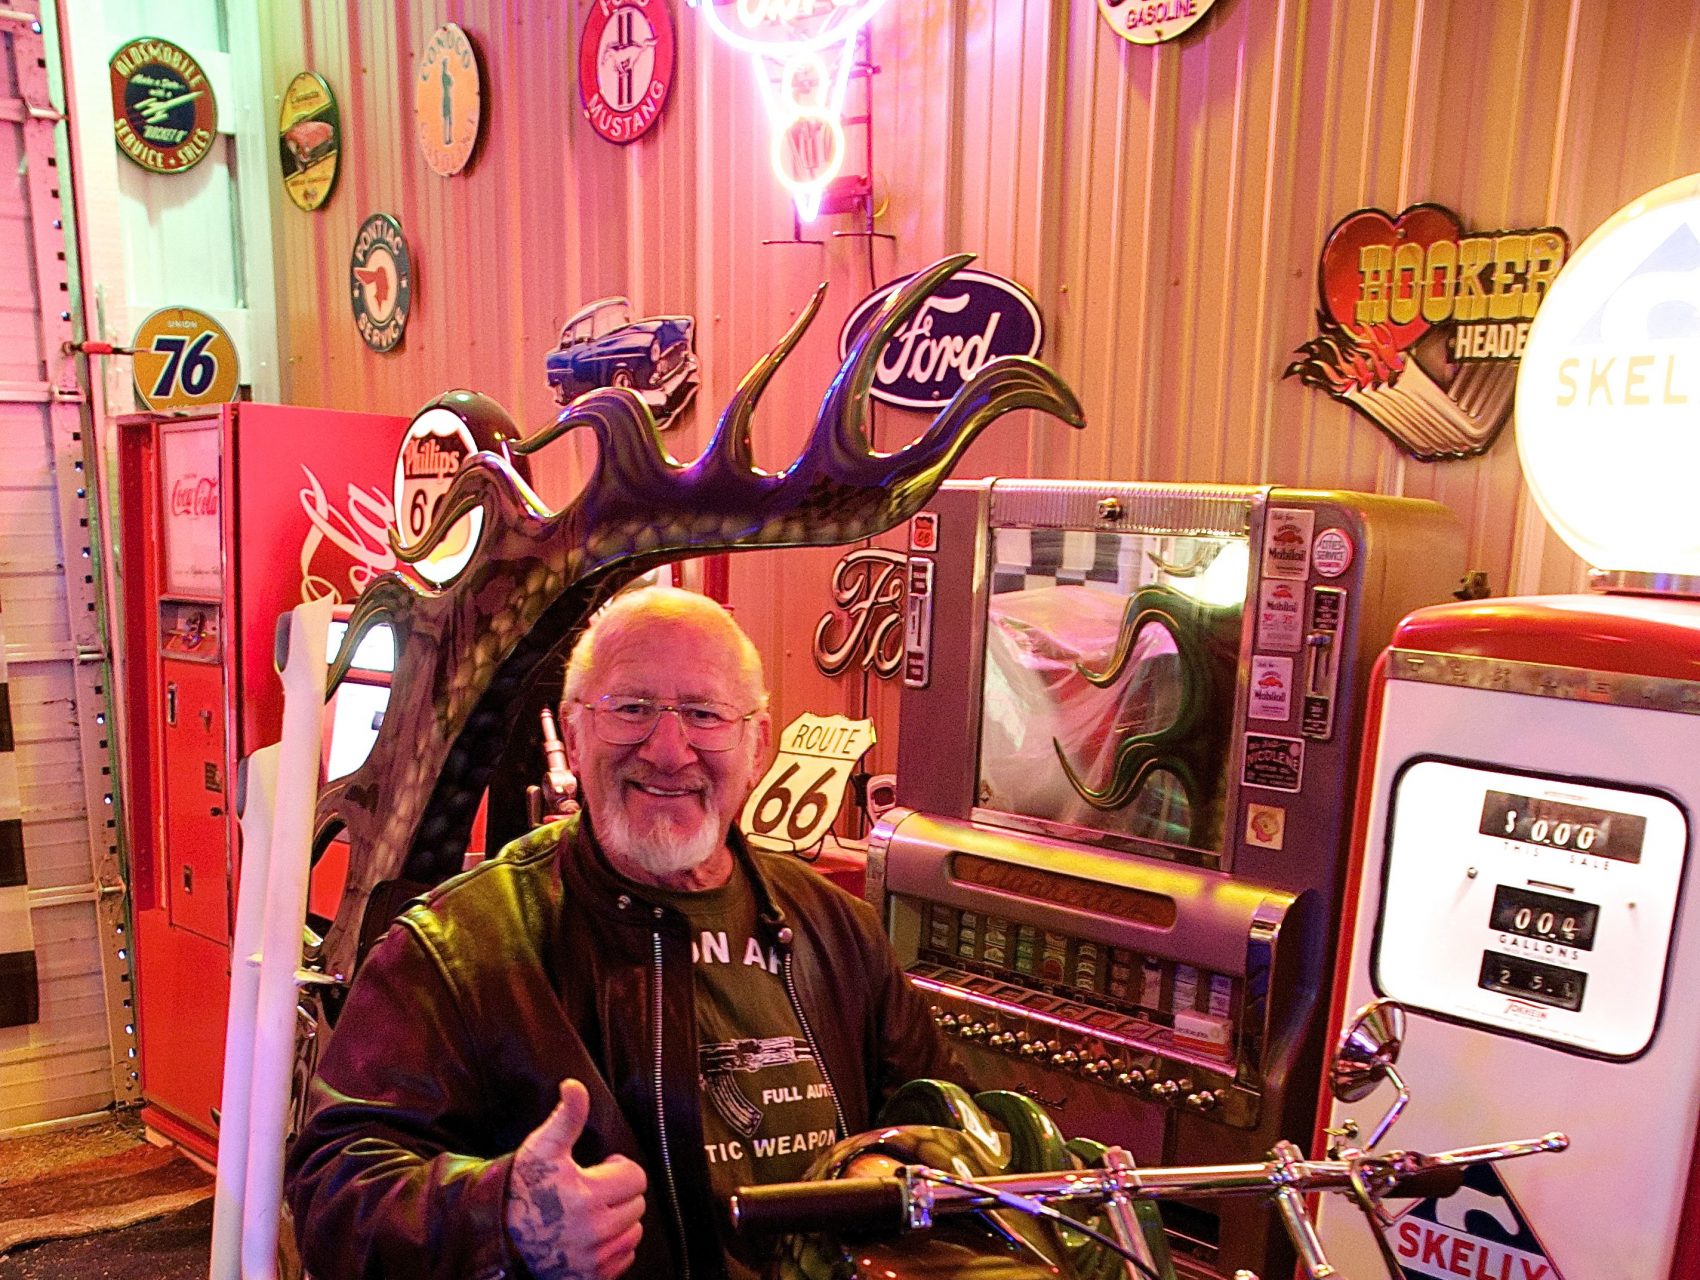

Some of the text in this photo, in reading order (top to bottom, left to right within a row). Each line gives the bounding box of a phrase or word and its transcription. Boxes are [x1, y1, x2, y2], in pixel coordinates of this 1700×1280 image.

[1127, 0, 1197, 29] GASOLINE
[115, 42, 203, 88] OLDSMOBILE
[589, 80, 664, 139] MUSTANG
[114, 118, 210, 168] SERVICE SALES
[355, 219, 402, 262] PONTIAC
[1356, 233, 1565, 325] HOOKER
[876, 293, 1001, 385] Ford
[149, 330, 219, 399] 76
[404, 439, 460, 482] Phillips
[792, 724, 861, 754] ROUTE
[752, 762, 837, 840] 66
[1503, 841, 1610, 871] THIS SALE
[1499, 934, 1580, 961] GALLONS
[762, 1086, 804, 1105] FULL
[704, 1129, 836, 1164] TIC WEAPON
